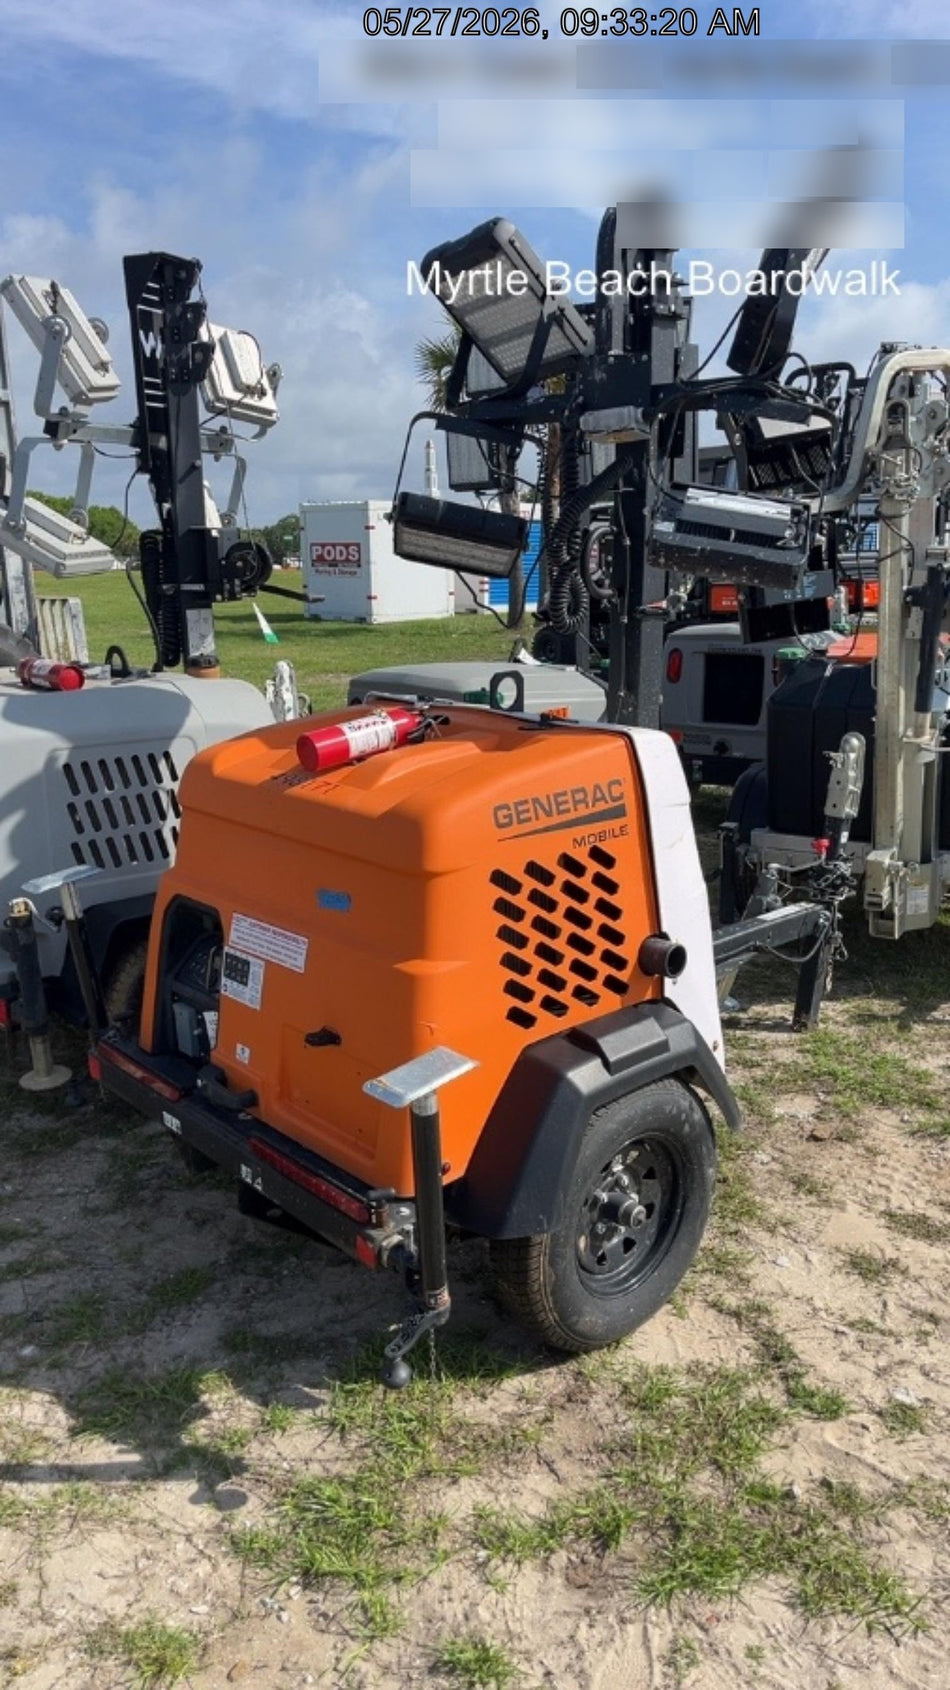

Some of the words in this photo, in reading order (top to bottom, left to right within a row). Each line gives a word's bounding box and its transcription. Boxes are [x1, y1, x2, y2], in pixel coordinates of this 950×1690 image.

[311, 545, 360, 561] PODS
[493, 778, 625, 829] GENERAC
[572, 823, 629, 849] MOBILE
